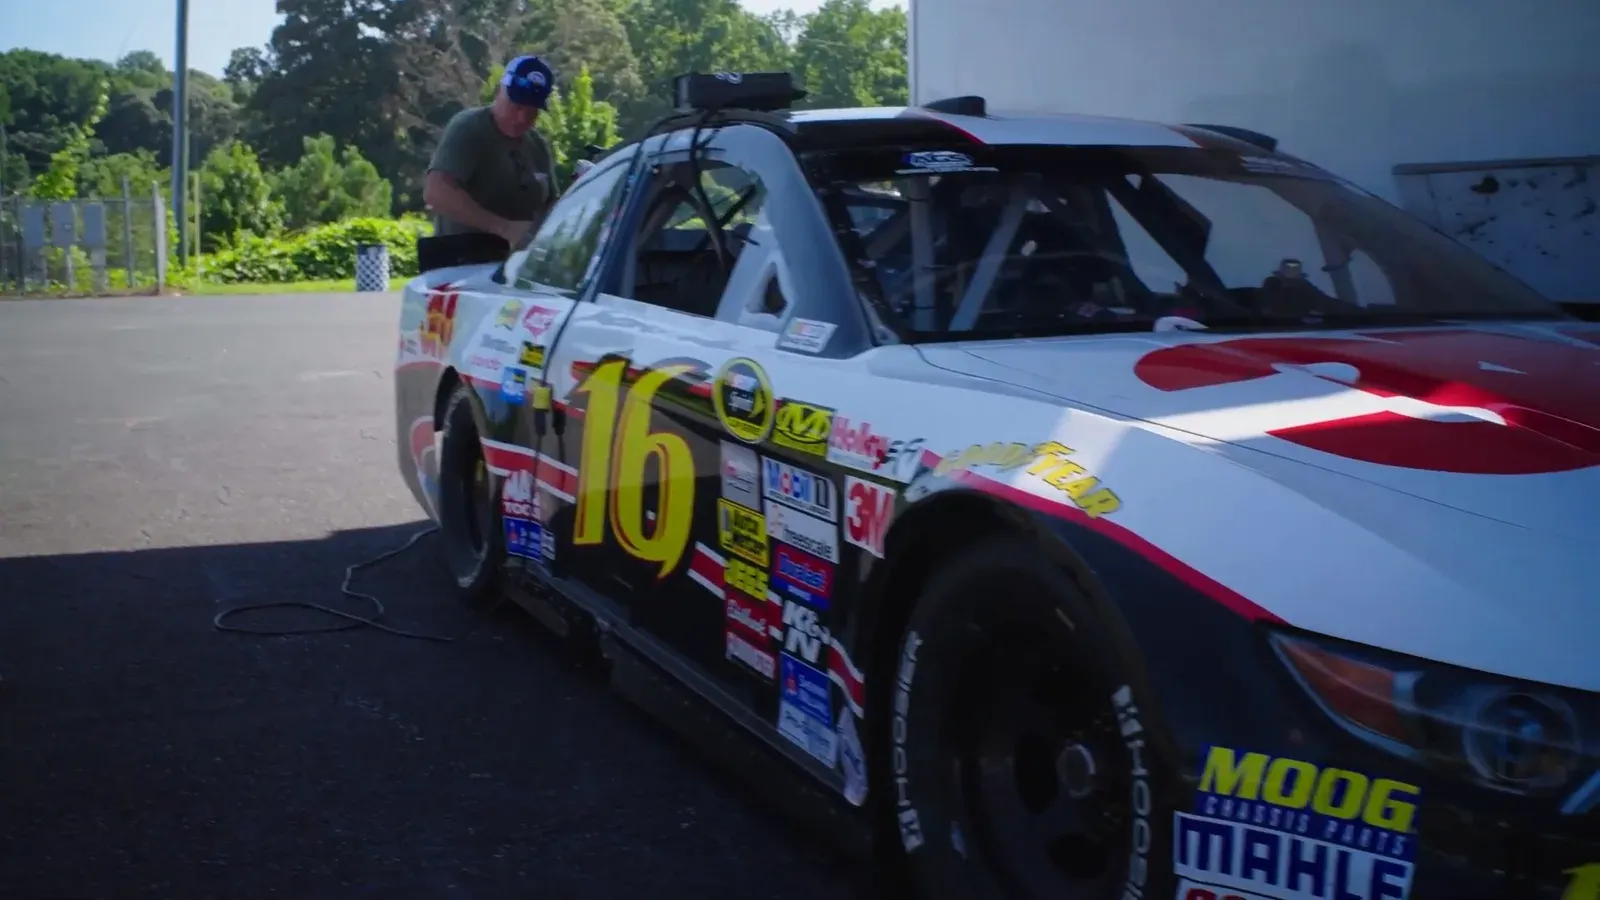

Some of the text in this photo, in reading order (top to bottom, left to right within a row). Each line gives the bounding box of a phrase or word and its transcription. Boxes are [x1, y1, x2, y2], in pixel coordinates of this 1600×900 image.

[572, 359, 697, 580] 16
[848, 482, 895, 554] 3M
[724, 558, 770, 601] JEGS
[1198, 745, 1422, 834] MOOG
[1205, 796, 1407, 856] CHASSIS PARTS
[1179, 817, 1412, 900] MAHLE
